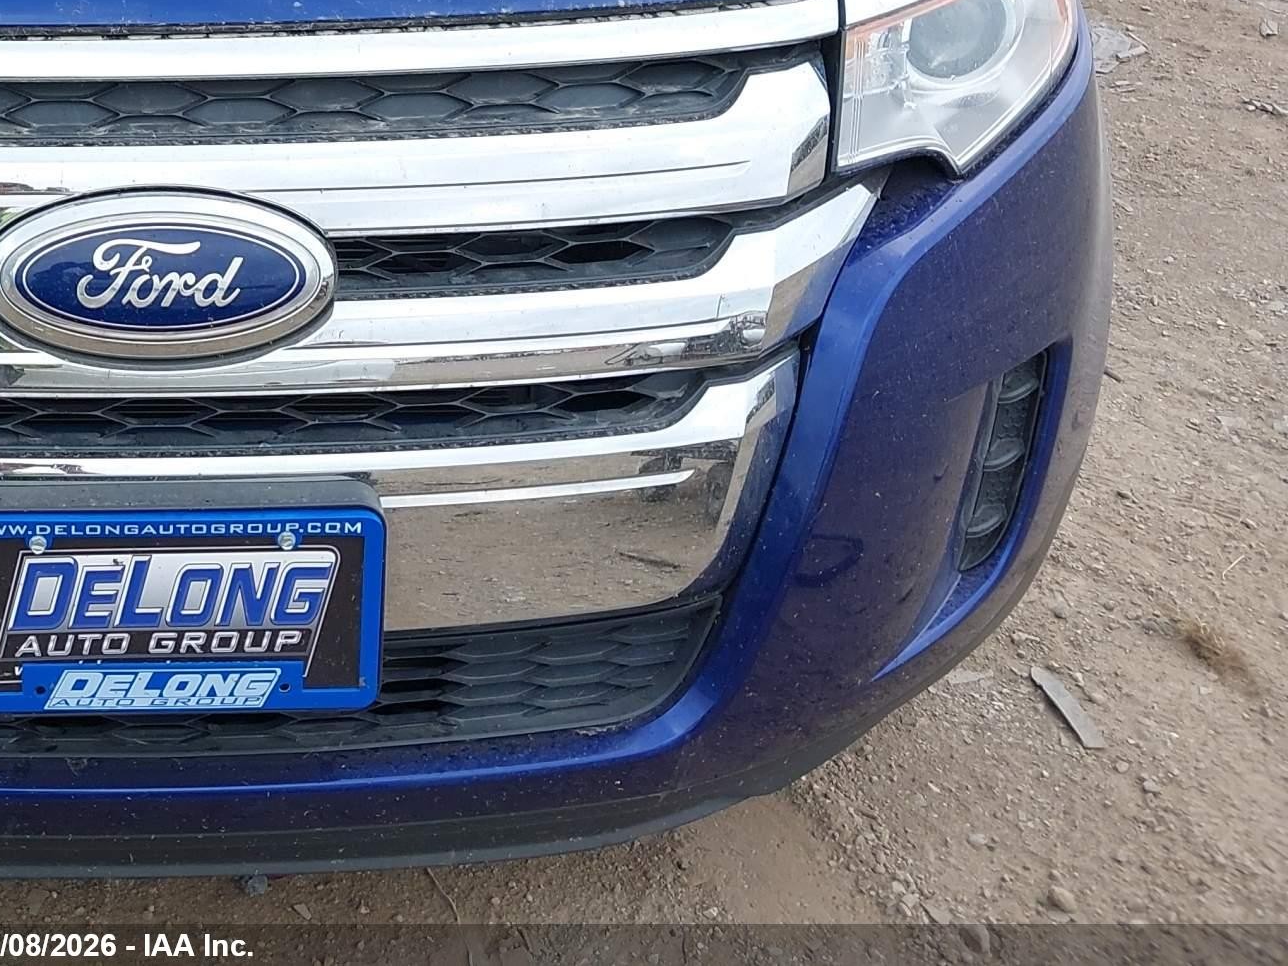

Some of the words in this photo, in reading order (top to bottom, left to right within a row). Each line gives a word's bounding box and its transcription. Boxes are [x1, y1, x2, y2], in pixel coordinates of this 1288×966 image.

[77, 238, 244, 308] Ford
[14, 633, 131, 657] AUTO
[148, 630, 303, 655] GROUP
[51, 697, 139, 707] AUTO
[150, 696, 262, 707] GROUP
